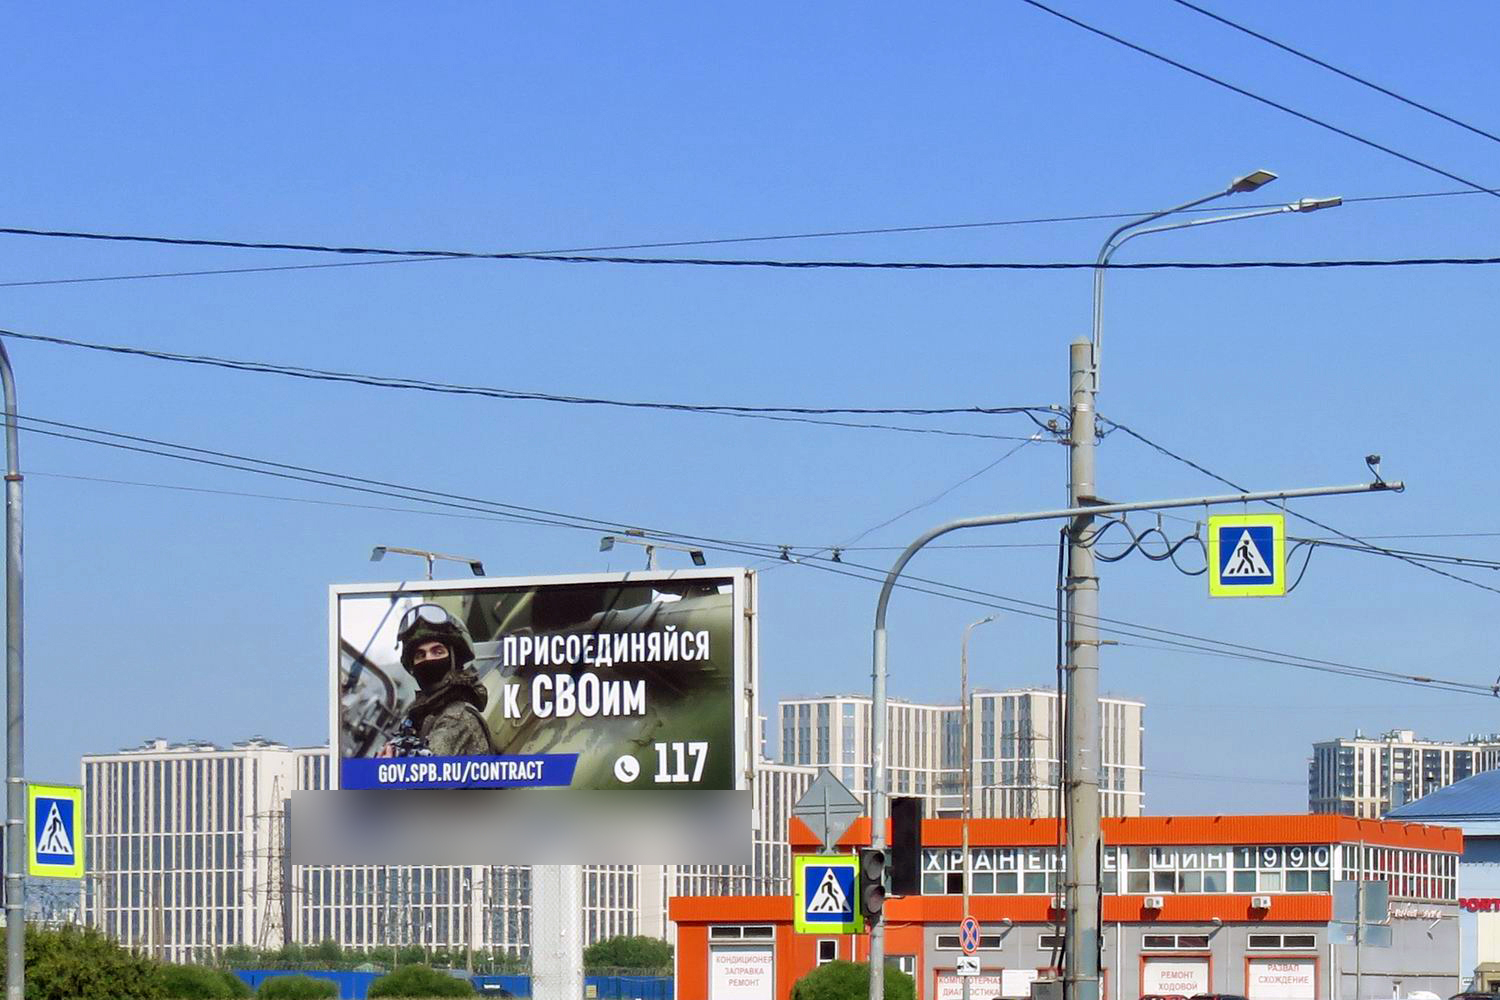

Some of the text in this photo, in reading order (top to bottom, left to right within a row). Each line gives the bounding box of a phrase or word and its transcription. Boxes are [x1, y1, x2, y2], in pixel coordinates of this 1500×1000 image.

[503, 625, 710, 667] ПРИСОЕДИНЯЙСЯ
[654, 742, 709, 783] 117
[378, 761, 544, 783] GOV.SPB.RU/CONTRACT
[926, 846, 1329, 871] ХРАНЕНЕ ШИН 1990
[724, 967, 765, 976] ЗАПРАВКА
[1160, 970, 1194, 980] РЕМОНТ
[728, 978, 760, 987] РЕМОНТ
[1257, 975, 1310, 985] СХОЖДЕНИЕ
[942, 988, 1001, 997] ДИАГОСТИКА
